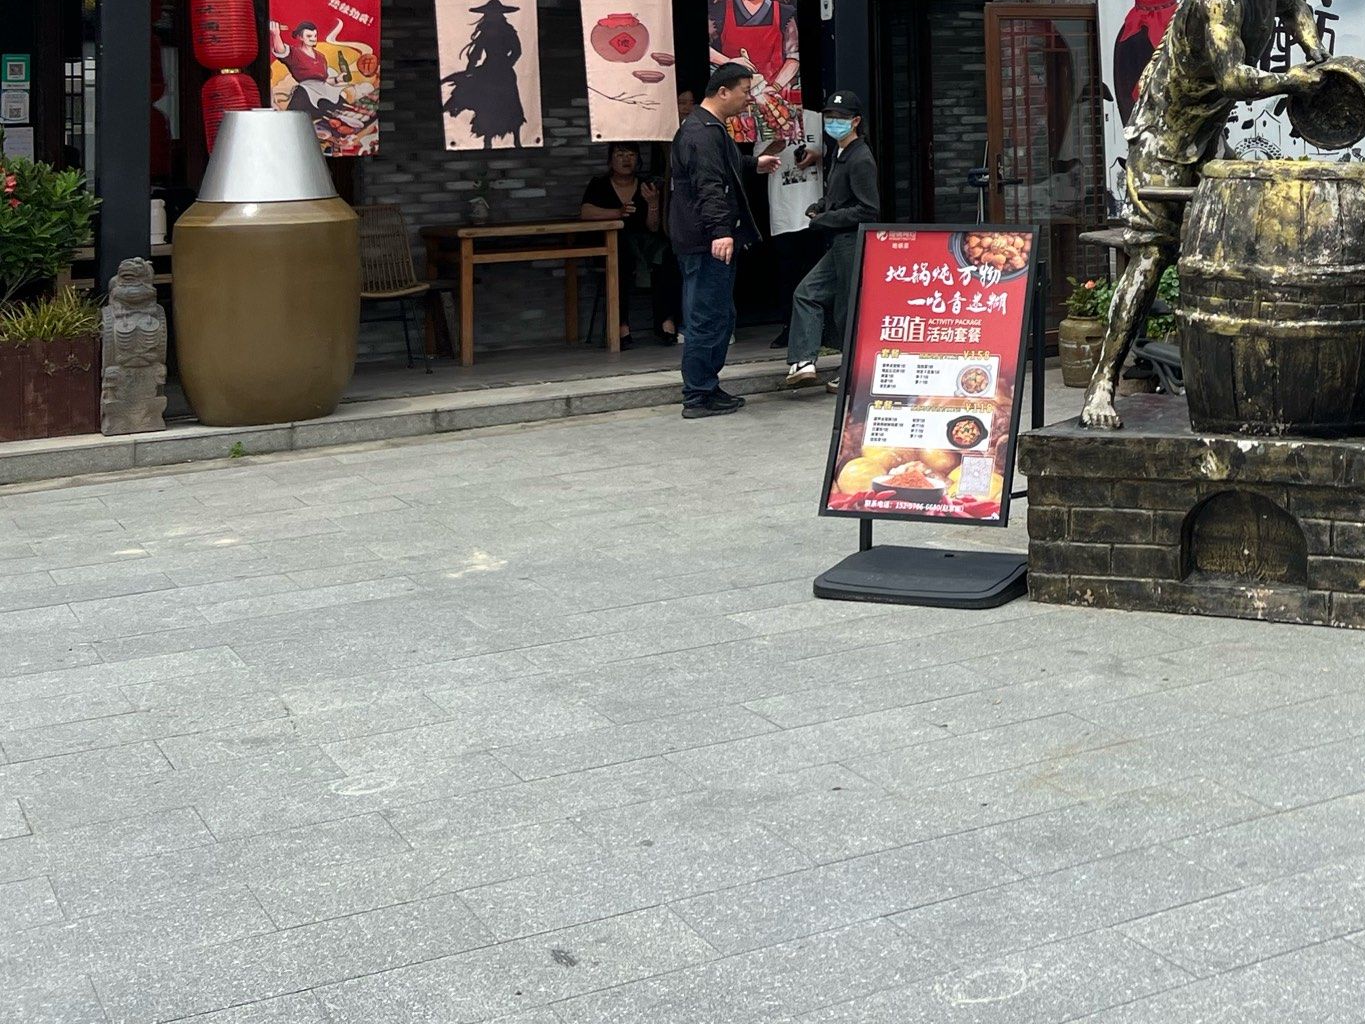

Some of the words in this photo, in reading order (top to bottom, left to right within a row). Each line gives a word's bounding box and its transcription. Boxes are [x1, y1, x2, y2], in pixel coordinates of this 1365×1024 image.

[884, 262, 1001, 289] 地锅炖万物
[907, 290, 1008, 316] 一吃香迷糊
[880, 315, 926, 343] 超值
[927, 327, 982, 343] 活动套餐
[928, 318, 954, 326] ACTIVITY
[955, 318, 982, 326] PACKAGE
